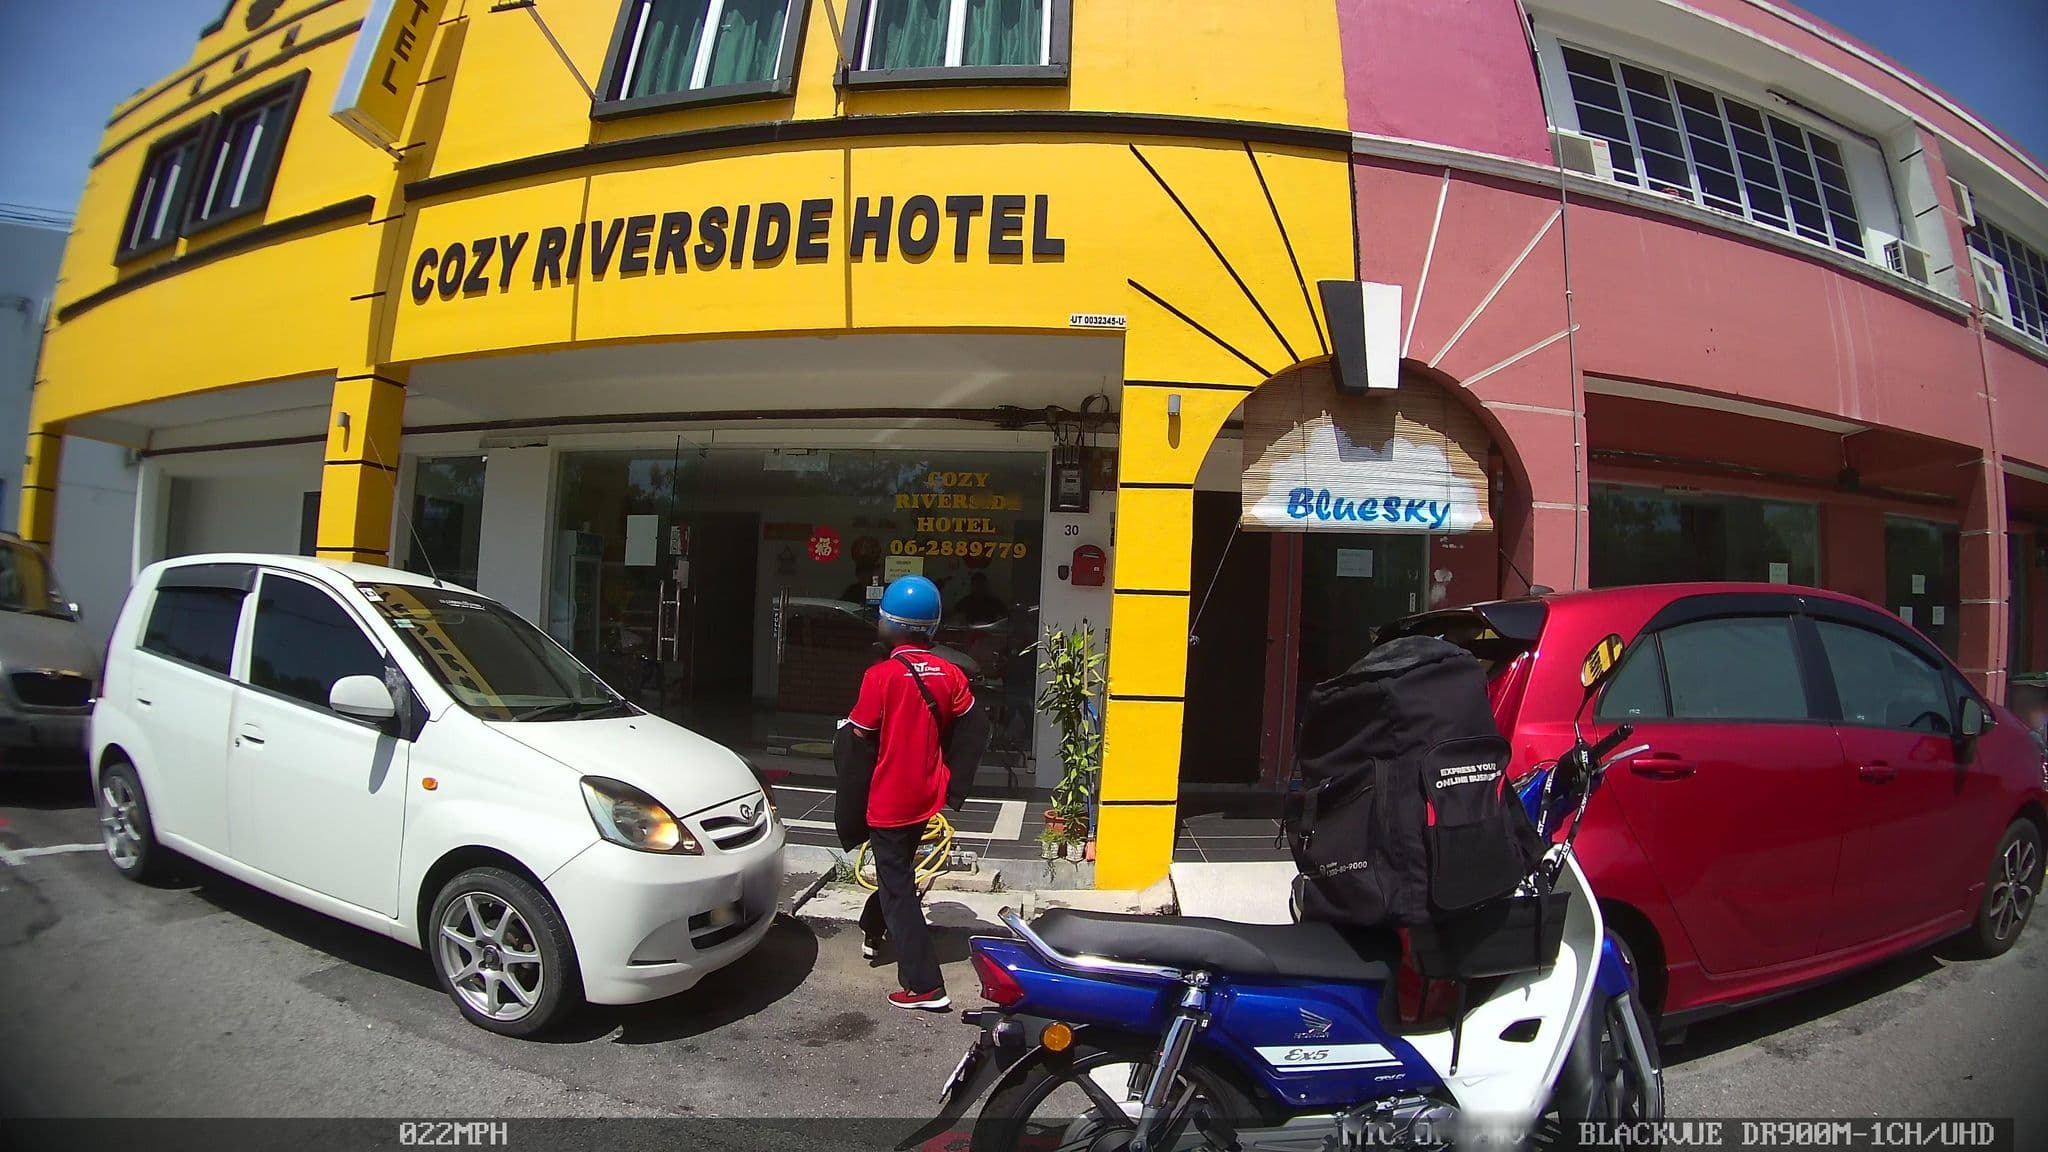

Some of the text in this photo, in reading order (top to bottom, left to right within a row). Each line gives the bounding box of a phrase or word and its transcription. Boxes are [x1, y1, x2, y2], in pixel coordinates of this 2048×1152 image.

[412, 194, 1065, 304] COZY RIVERSIDE HOTEL
[927, 471, 991, 488] COZY
[895, 492, 1024, 511] RIVERD
[917, 517, 996, 533] HOTEL
[1064, 524, 1079, 536] 30
[815, 537, 832, 556] 福
[889, 539, 1027, 560] 06-2889779
[1440, 765, 1477, 777] EXPRESS
